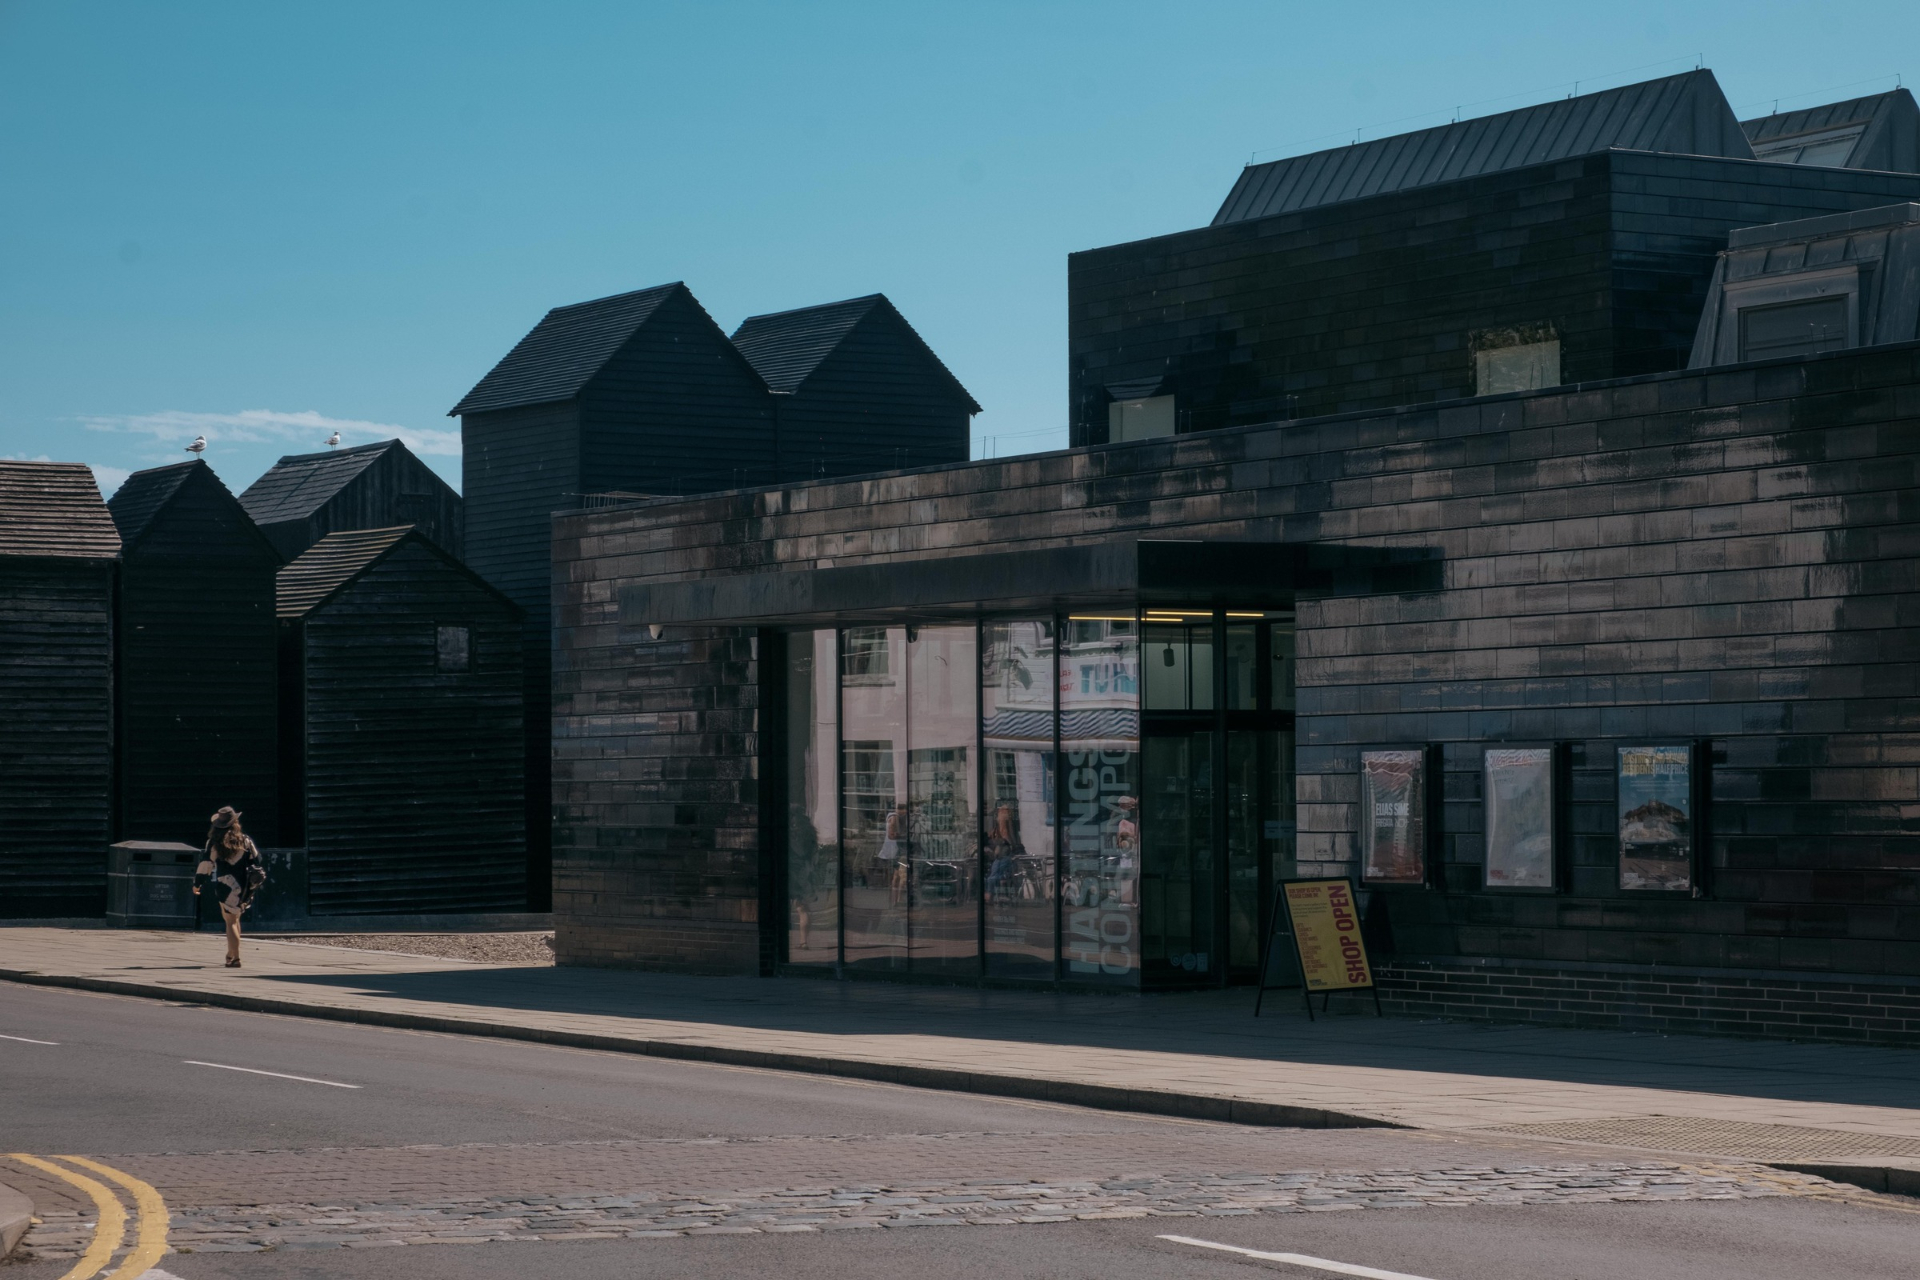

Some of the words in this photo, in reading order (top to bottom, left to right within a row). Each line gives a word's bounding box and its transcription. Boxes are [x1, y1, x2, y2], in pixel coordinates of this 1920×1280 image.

[1622, 764, 1654, 775] RESIDENTS
[1655, 764, 1670, 775] HALF
[1671, 763, 1688, 774] PRICE
[1376, 802, 1393, 816] ELIAS
[1394, 802, 1410, 816] SIME
[1068, 744, 1099, 975] HASTINGS
[1328, 885, 1355, 931] OPEN
[1339, 936, 1366, 983] SHOP
